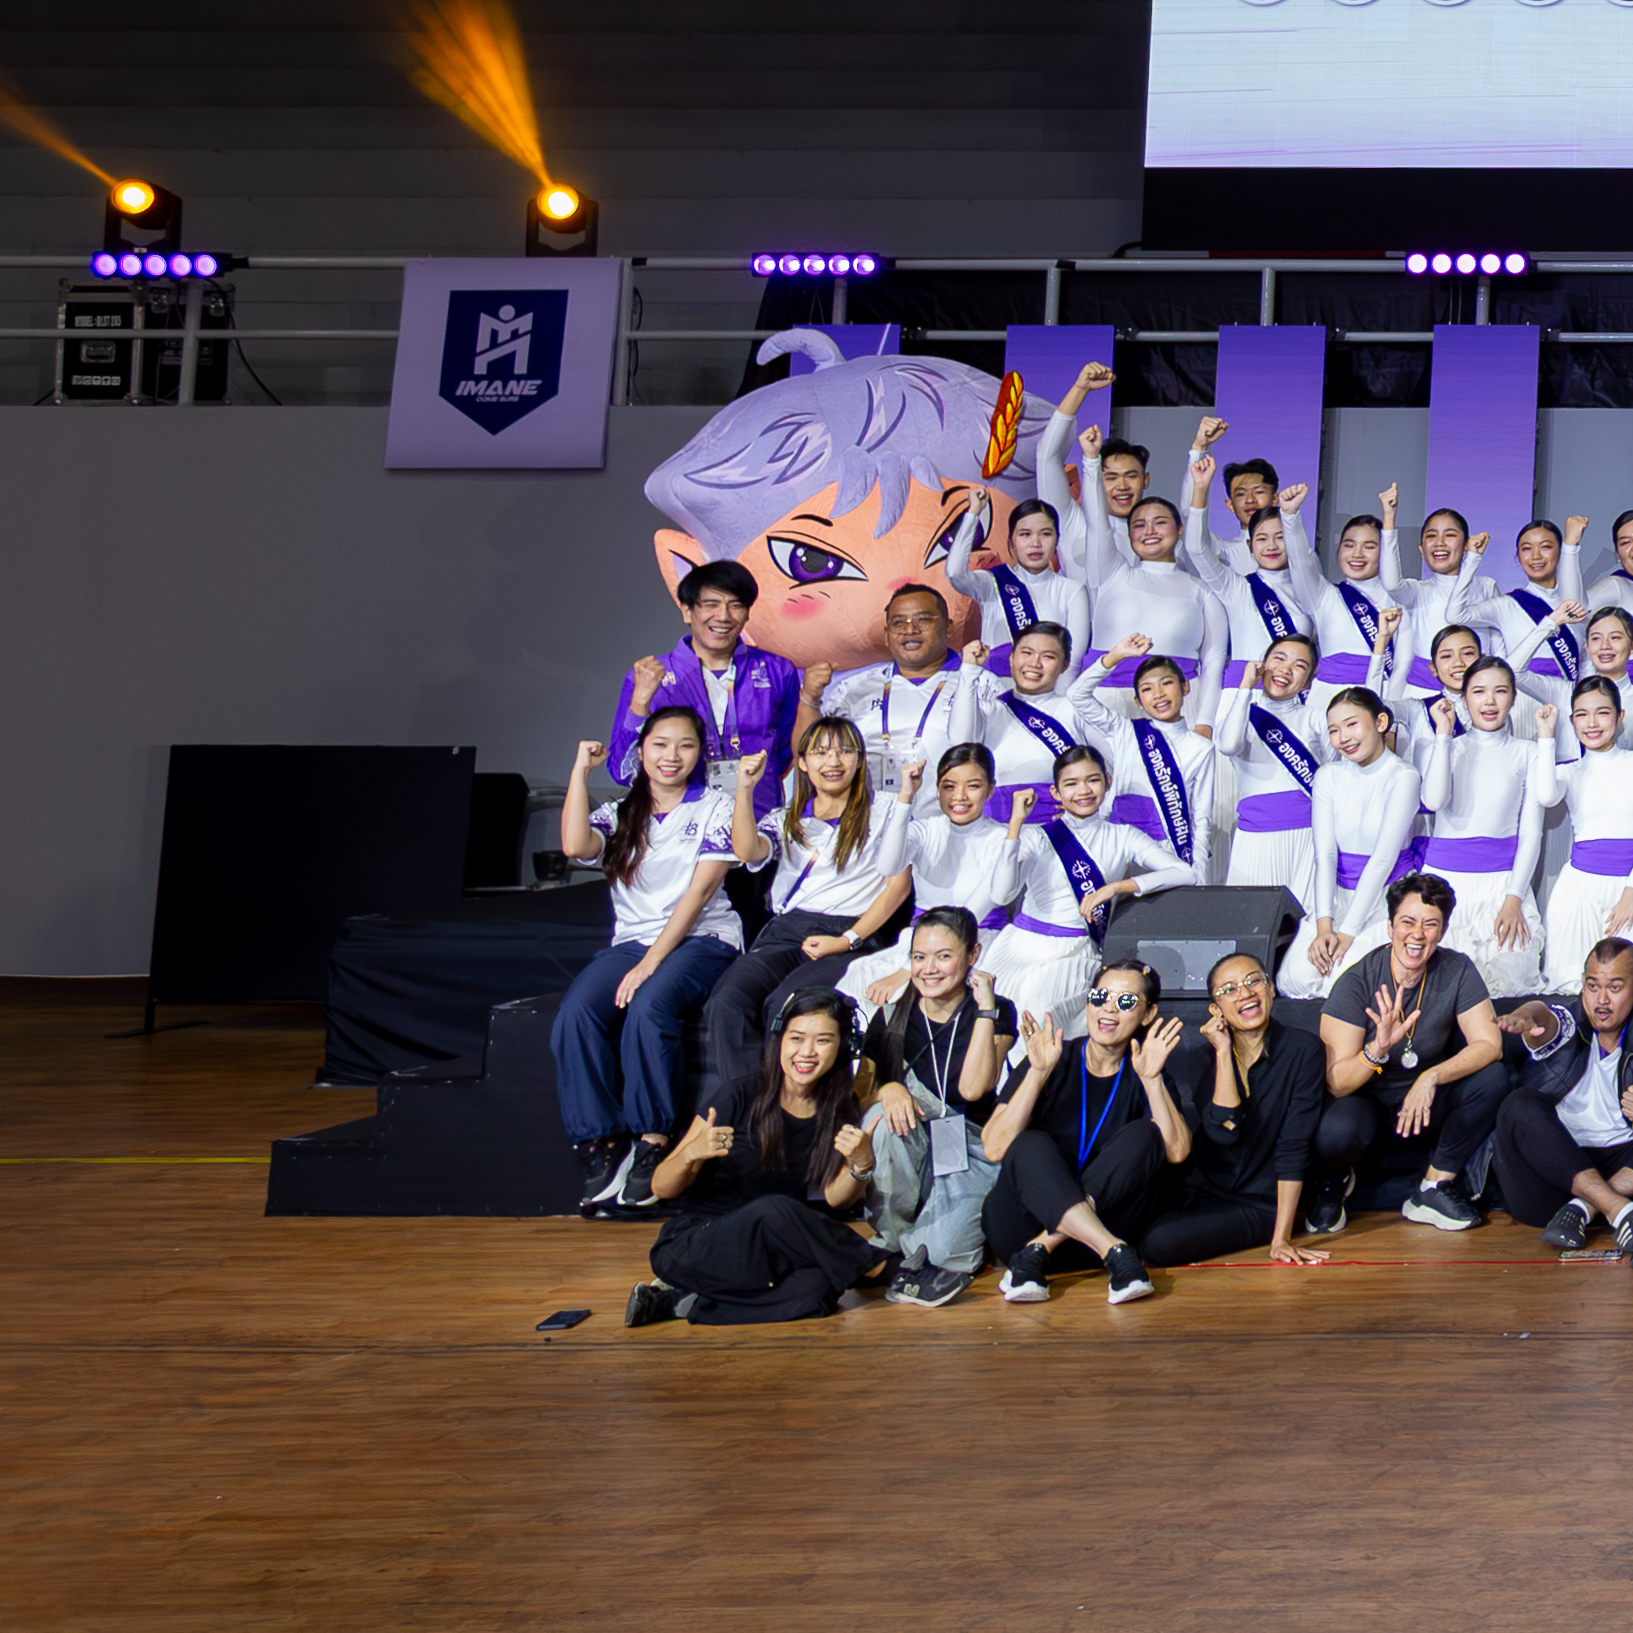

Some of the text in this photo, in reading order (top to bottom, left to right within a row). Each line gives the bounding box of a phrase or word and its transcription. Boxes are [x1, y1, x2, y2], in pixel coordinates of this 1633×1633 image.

[455, 379, 543, 396] IMANE
[1148, 748, 1190, 845] องครักษ์พิทักษ์ฝัน
